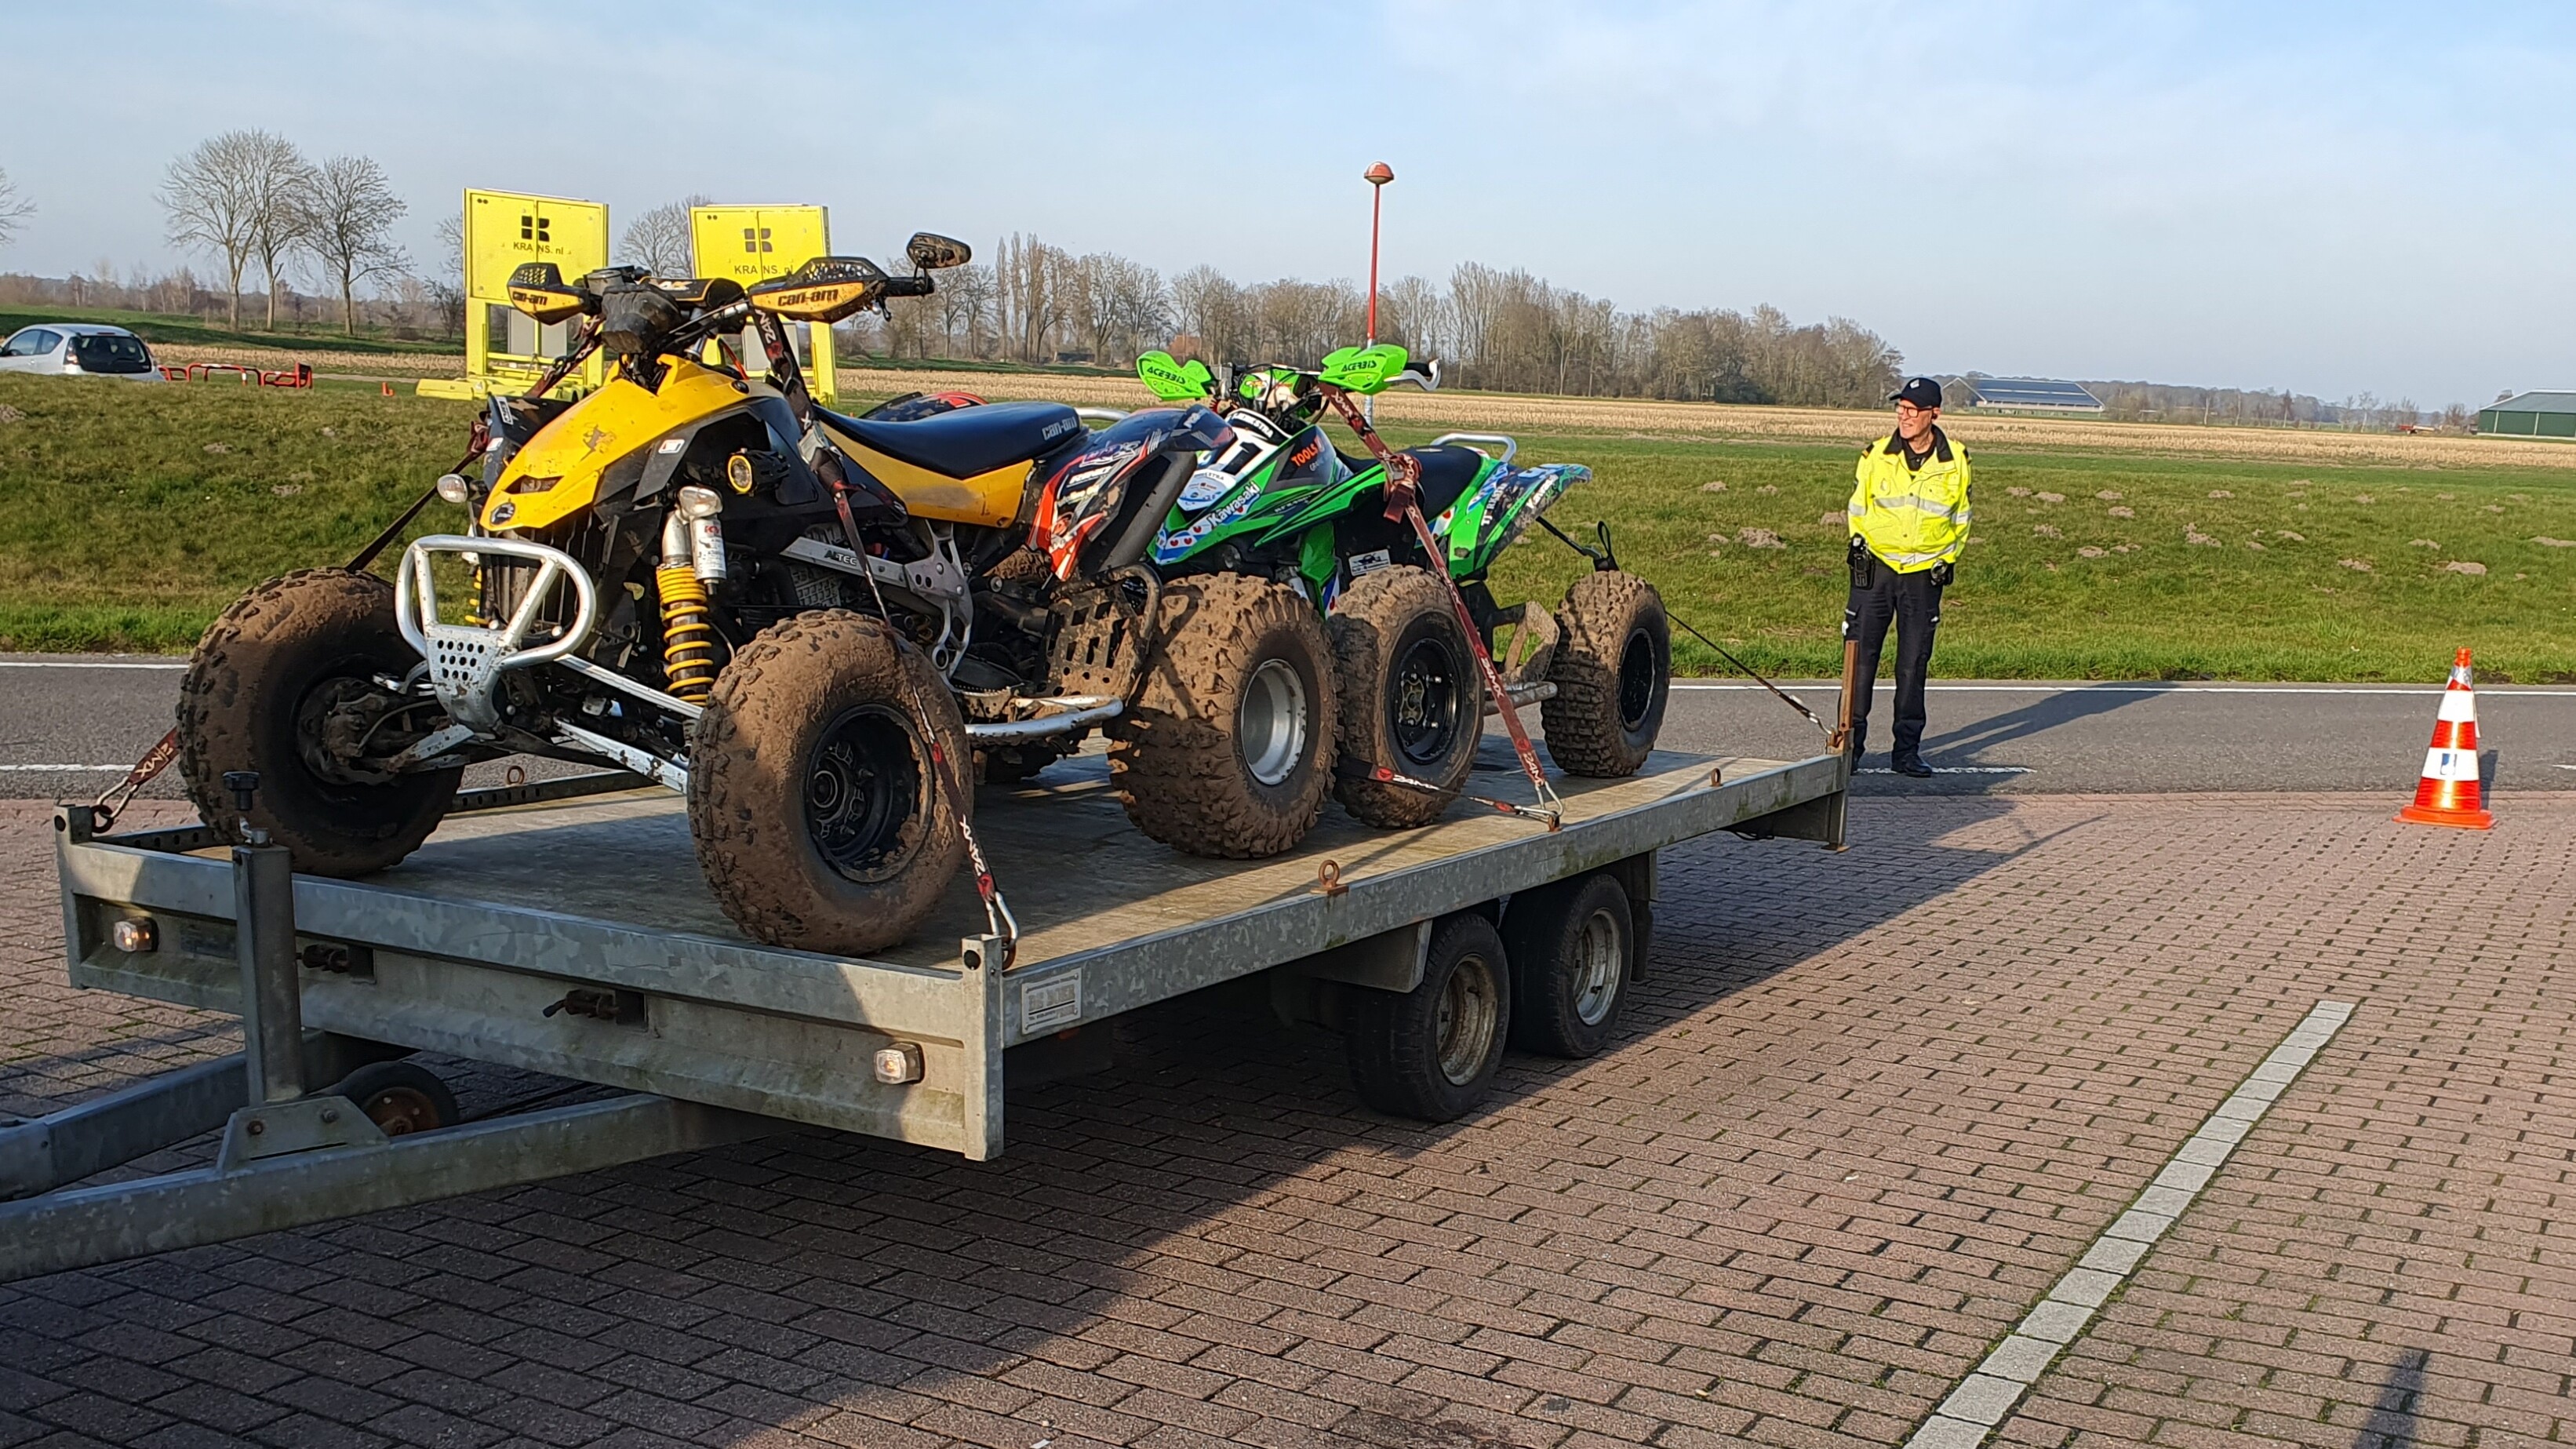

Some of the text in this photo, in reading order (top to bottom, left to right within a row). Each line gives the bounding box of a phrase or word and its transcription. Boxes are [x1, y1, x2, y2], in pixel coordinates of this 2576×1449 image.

[757, 308, 777, 344] 24M
[1147, 366, 1186, 384] ACERBIS
[1341, 360, 1377, 373] ACERBIS
[1207, 480, 1261, 528] Kawasaki
